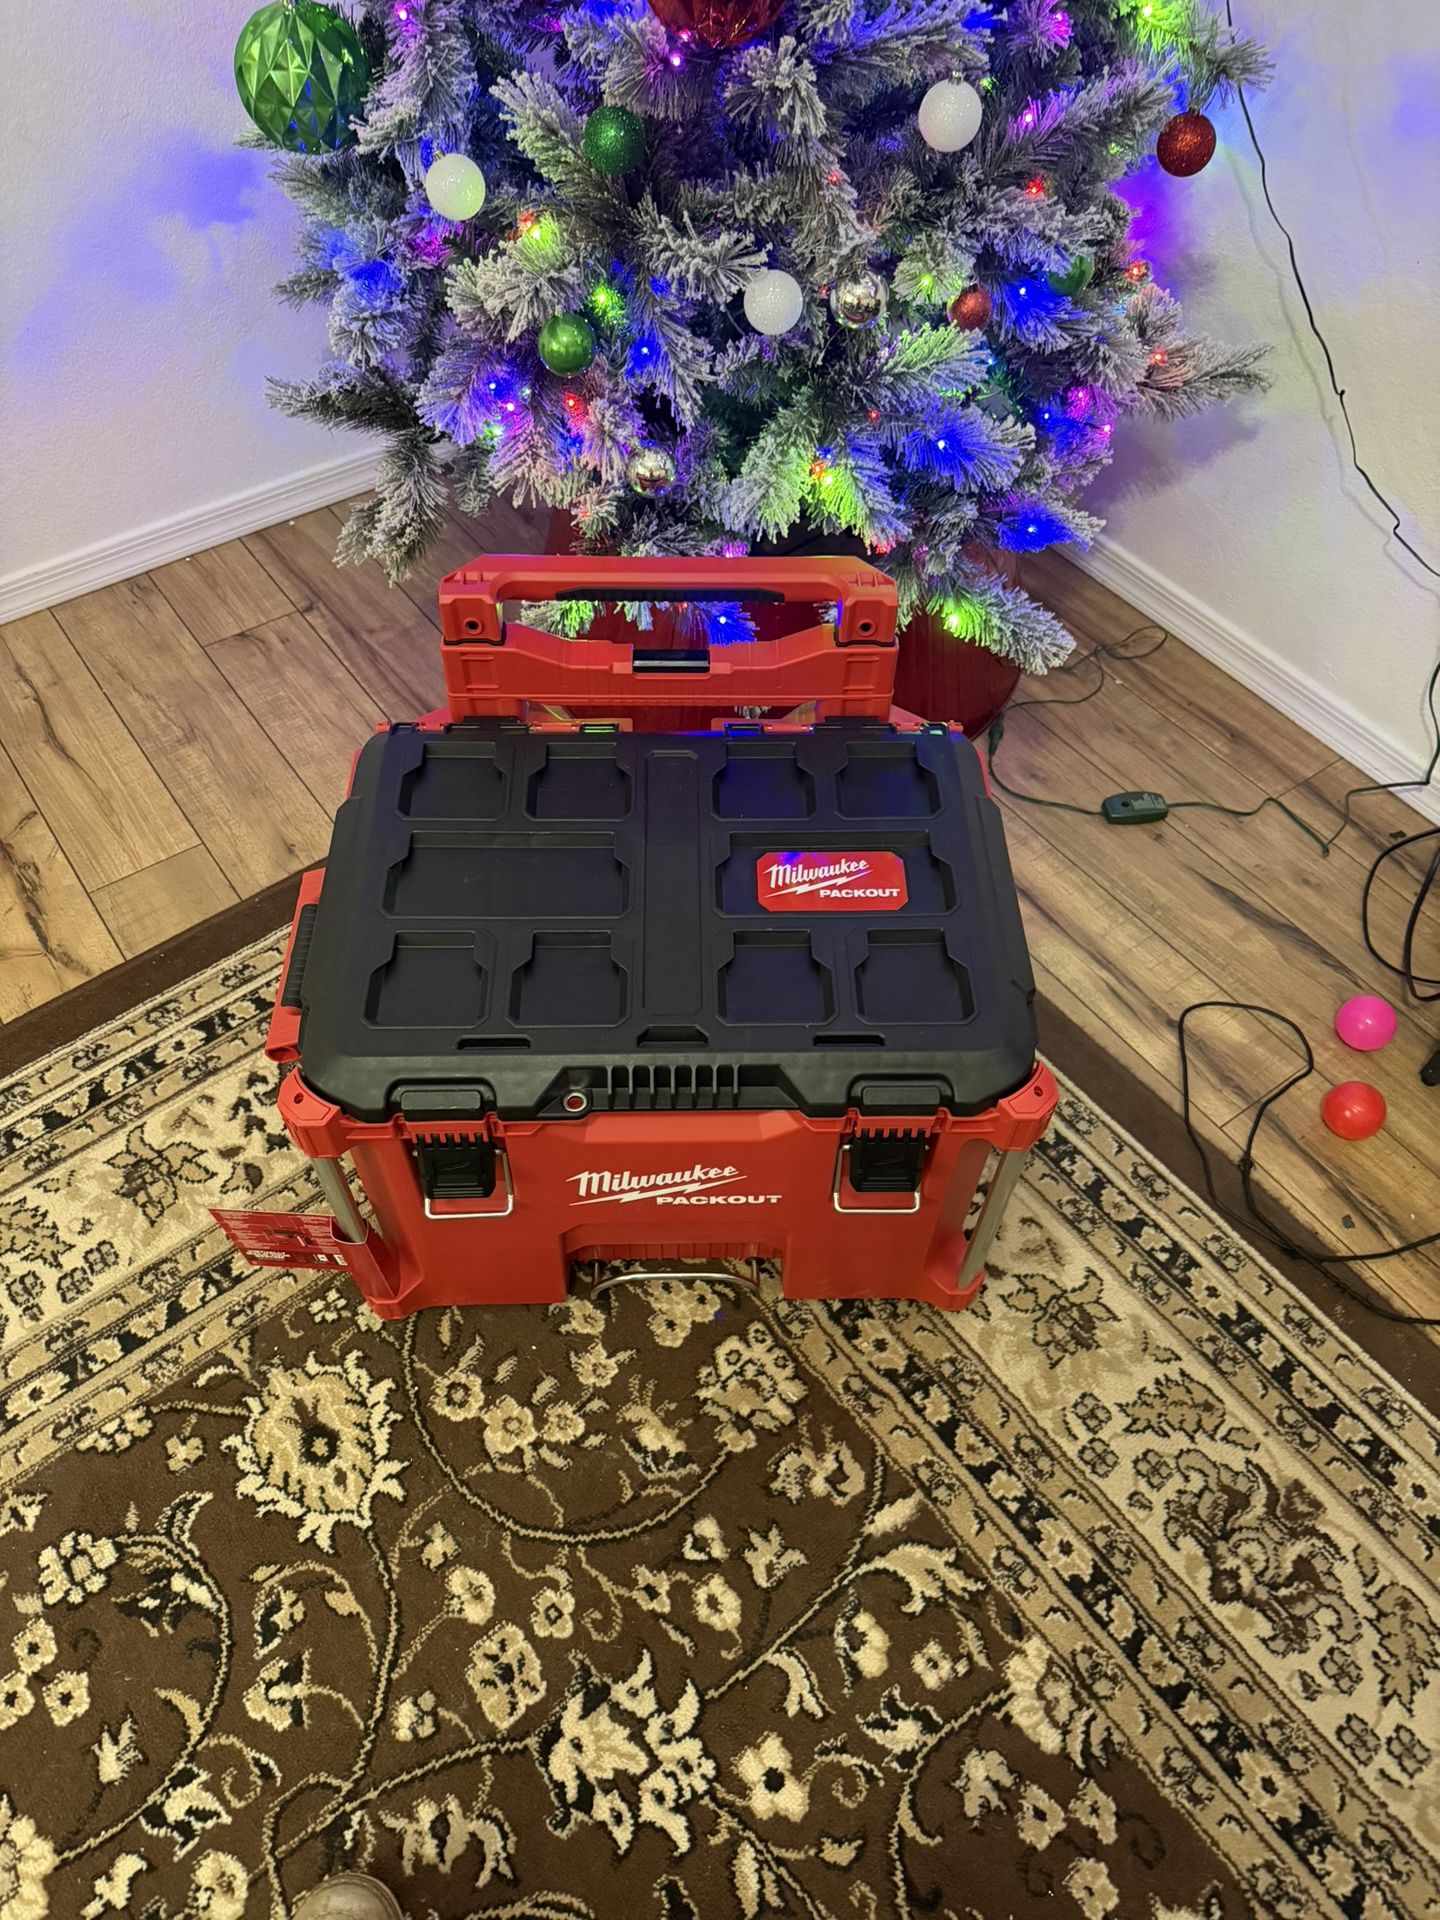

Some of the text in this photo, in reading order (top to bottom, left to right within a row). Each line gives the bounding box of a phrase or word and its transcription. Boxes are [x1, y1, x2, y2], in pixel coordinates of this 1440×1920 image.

[763, 858, 870, 889] Milwaukee
[819, 888, 901, 898] PACKOUT
[565, 1164, 740, 1197] Milwaukee
[656, 1195, 783, 1205] PACKOUT
